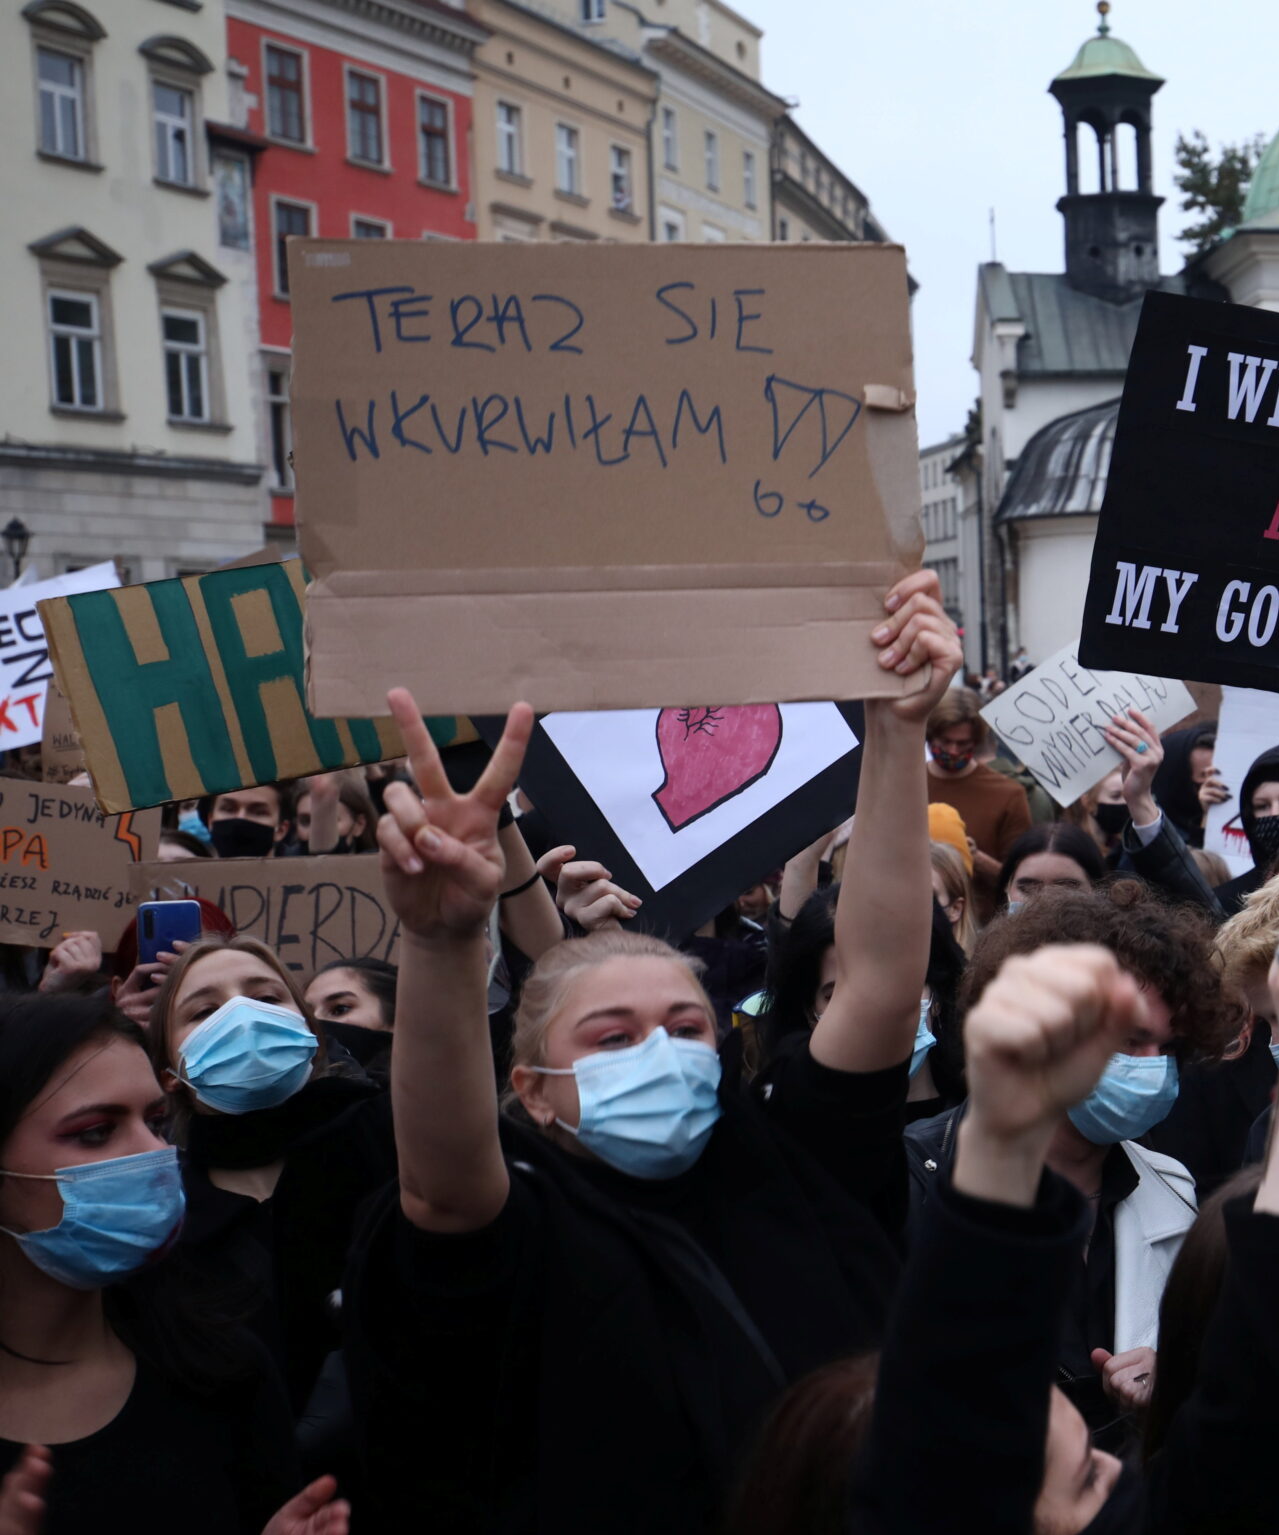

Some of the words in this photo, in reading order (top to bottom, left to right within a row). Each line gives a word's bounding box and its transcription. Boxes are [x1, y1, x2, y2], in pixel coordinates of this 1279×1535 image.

[655, 281, 775, 354] SIE
[1176, 344, 1208, 412] I
[1105, 560, 1199, 634] MY
[66, 562, 457, 808] HA
